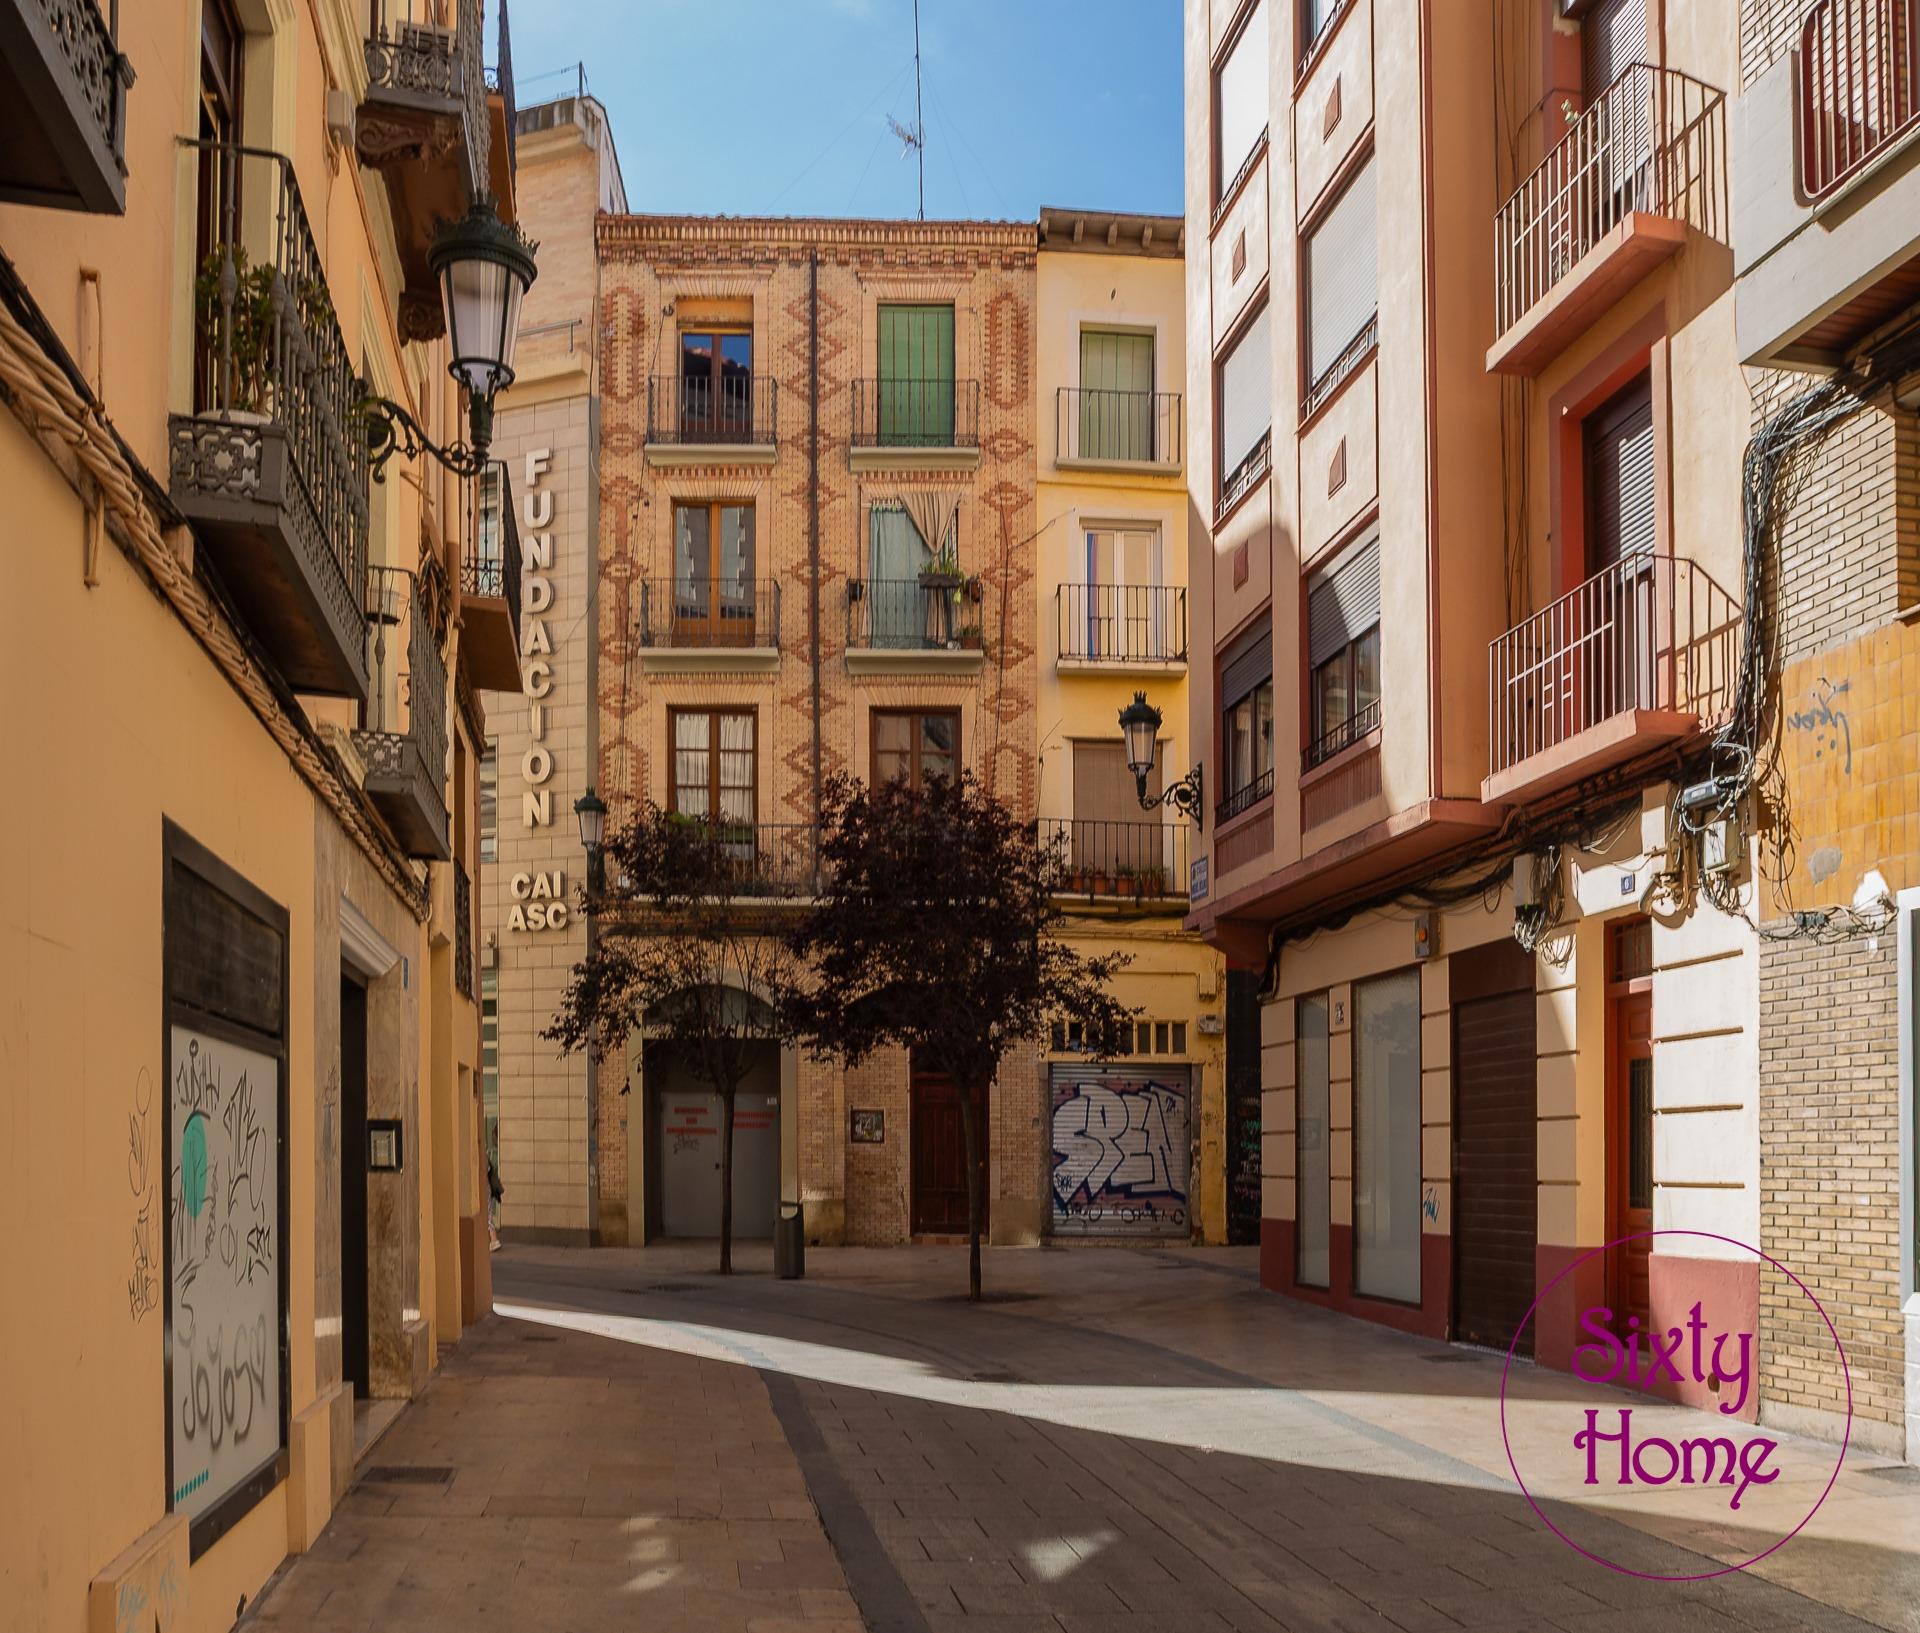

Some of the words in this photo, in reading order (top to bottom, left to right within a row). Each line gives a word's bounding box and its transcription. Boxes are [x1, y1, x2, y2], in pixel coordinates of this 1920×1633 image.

[522, 448, 553, 828] FUNDACION
[511, 871, 561, 899] CAI
[507, 902, 567, 931] ASC
